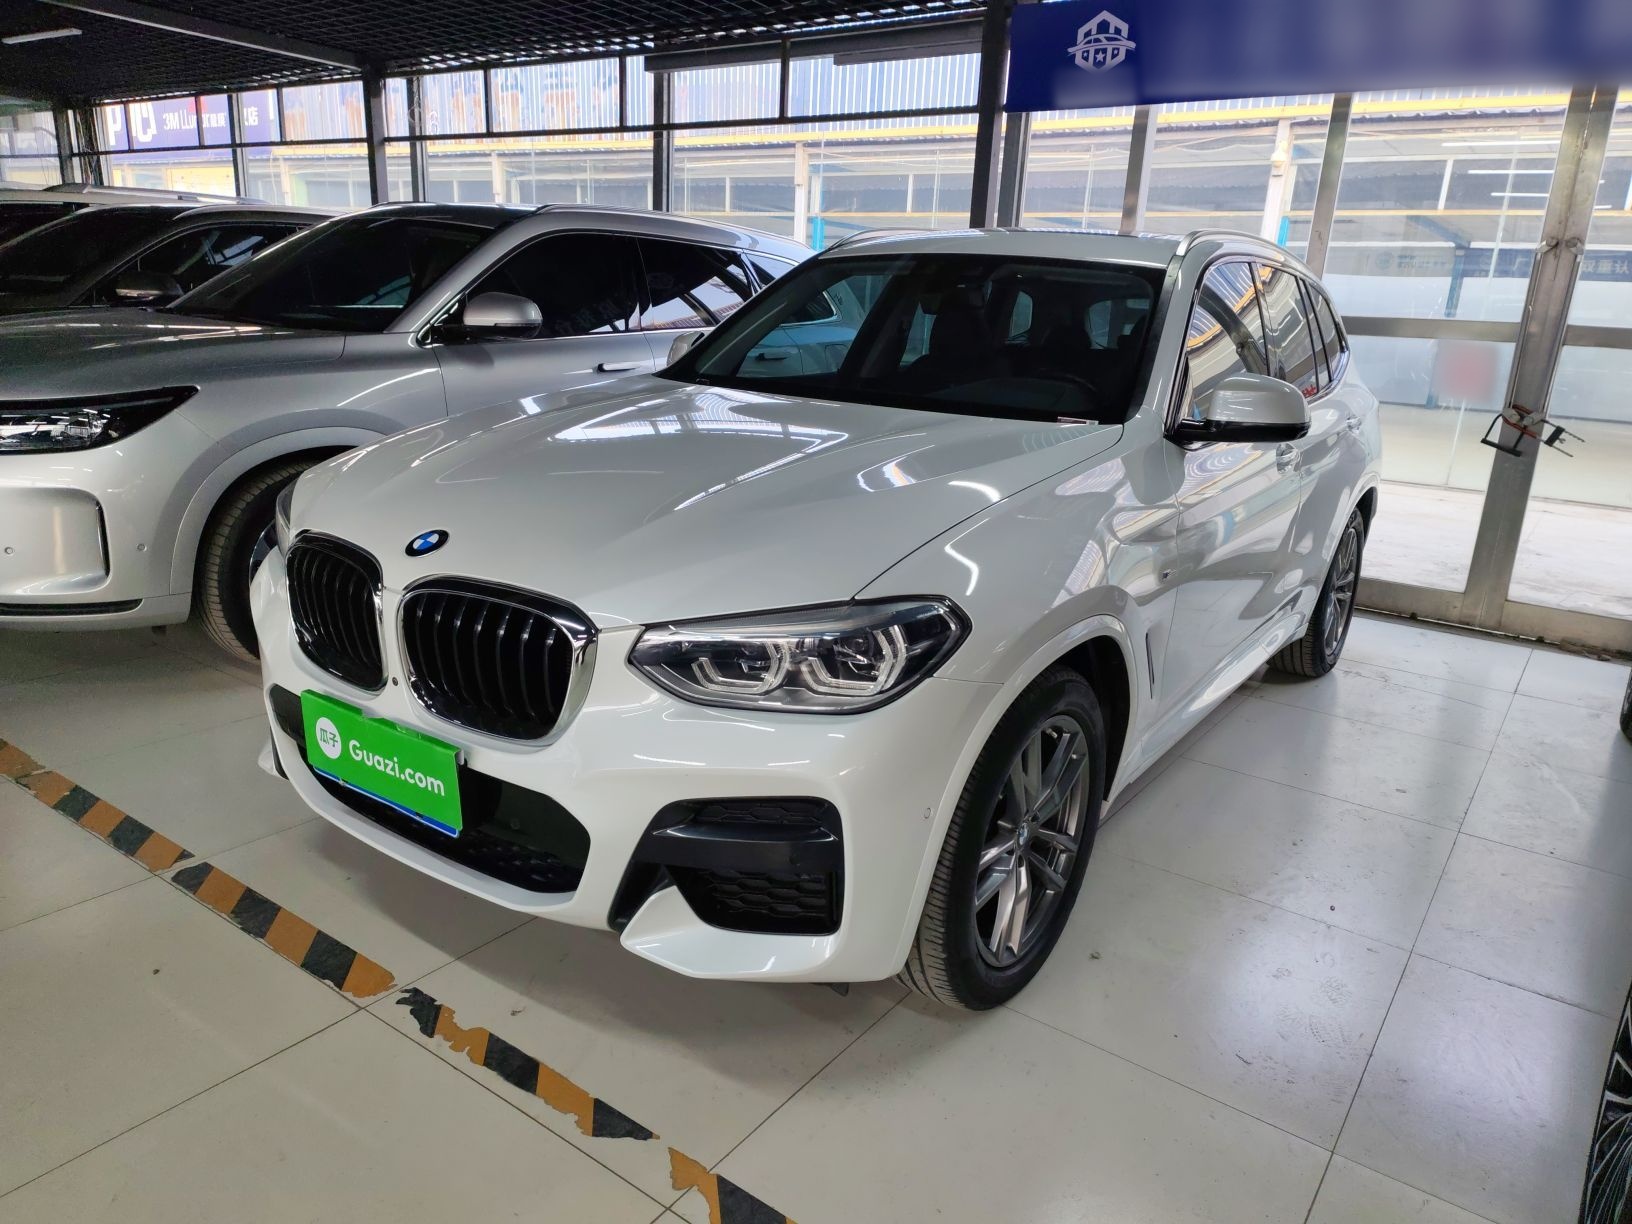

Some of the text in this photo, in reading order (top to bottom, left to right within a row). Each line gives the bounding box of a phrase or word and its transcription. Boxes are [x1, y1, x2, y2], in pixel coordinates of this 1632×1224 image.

[162, 112, 180, 130] 3M
[319, 727, 339, 748] 瓜子
[348, 738, 445, 797] Guazi.com
